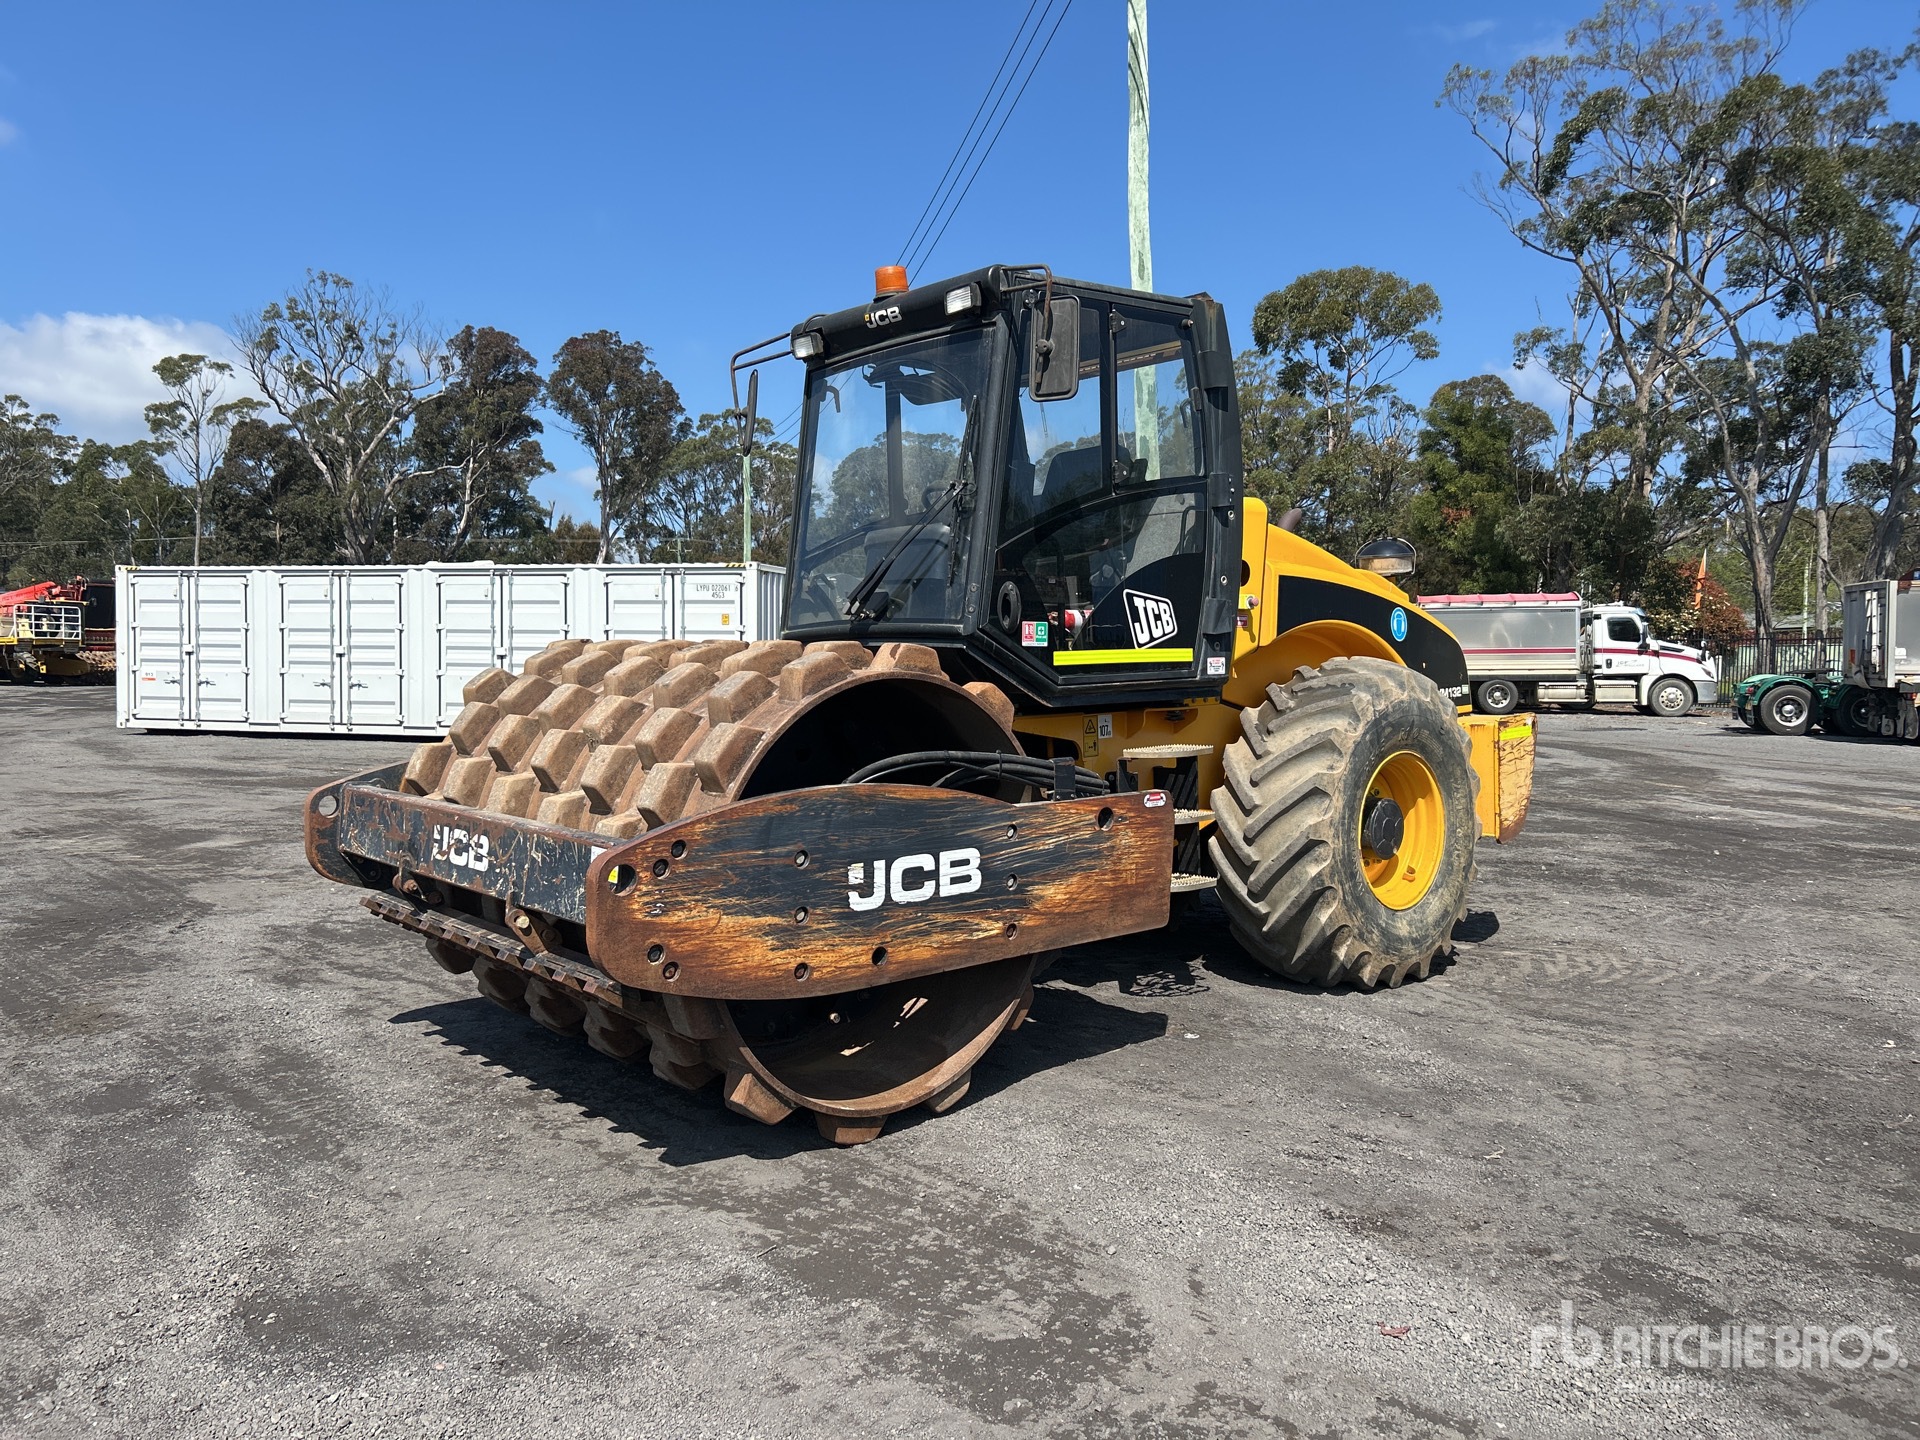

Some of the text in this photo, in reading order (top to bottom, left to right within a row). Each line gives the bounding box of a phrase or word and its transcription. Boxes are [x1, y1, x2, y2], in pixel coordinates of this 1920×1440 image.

[864, 306, 903, 329] JCB
[1132, 596, 1174, 644] JCB
[431, 825, 490, 872] JCB
[848, 847, 982, 911] JCB
